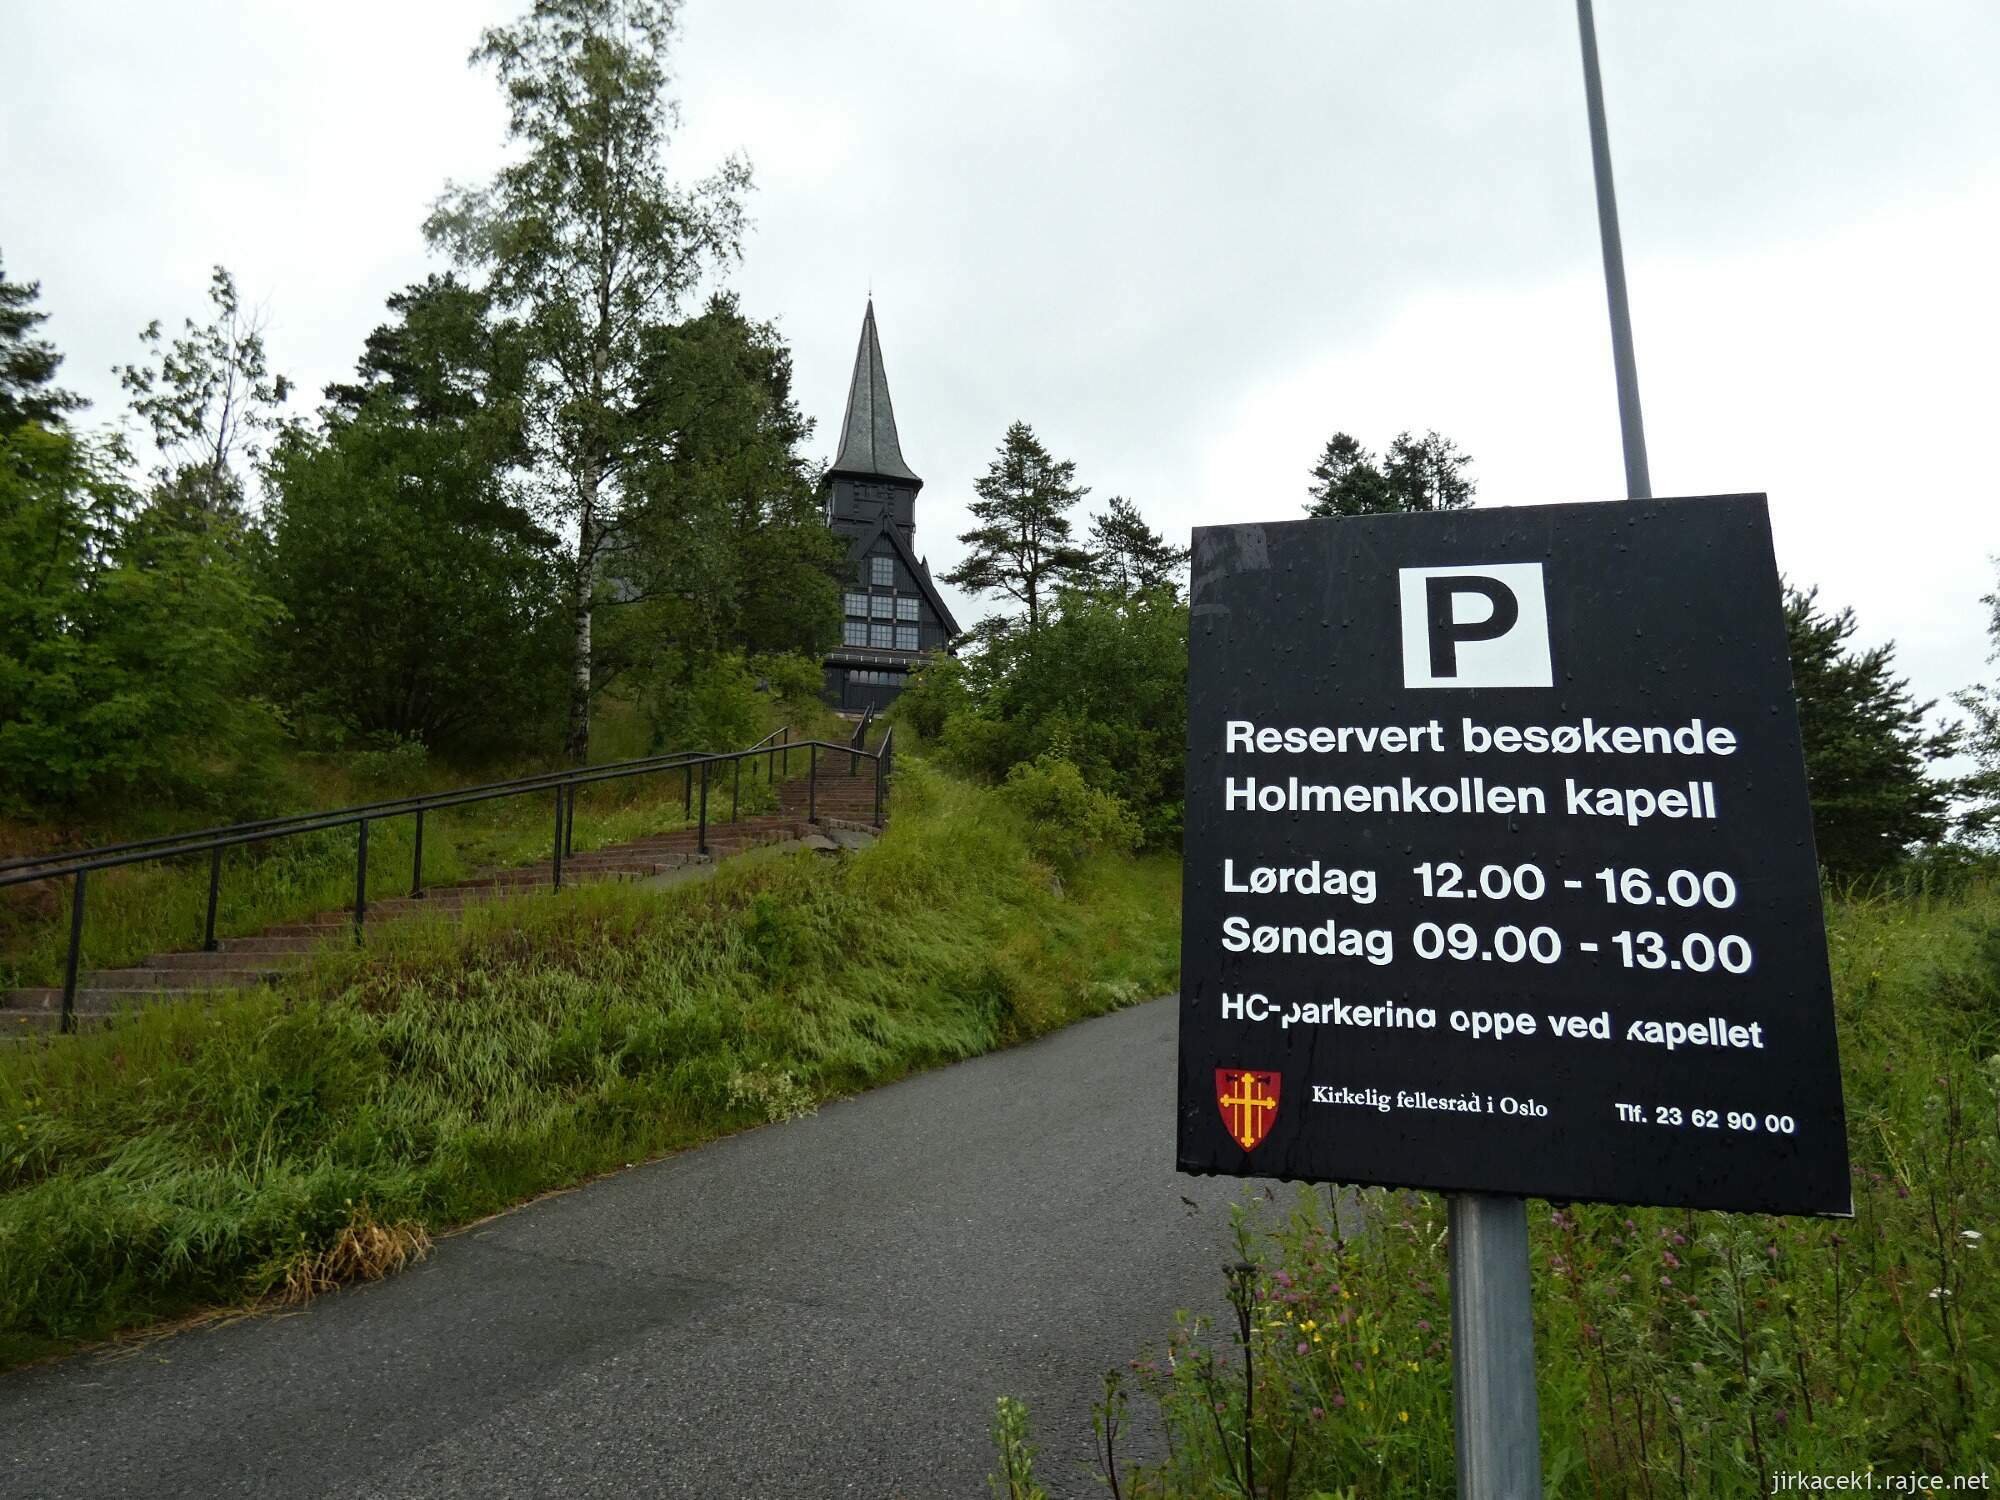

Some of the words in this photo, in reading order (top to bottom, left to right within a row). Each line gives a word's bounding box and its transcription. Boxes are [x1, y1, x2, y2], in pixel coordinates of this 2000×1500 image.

[1425, 575, 1518, 678] P
[1226, 719, 1445, 754] Reservert
[1462, 717, 1737, 755] besøkende
[1225, 776, 1546, 814] Holmenkollen
[1565, 778, 1717, 827] kapell
[1224, 858, 1377, 905] Lørdag
[1413, 862, 1546, 901] 12.00
[1595, 867, 1737, 909] 16.00
[1221, 916, 1394, 966] Søndag
[1412, 922, 1562, 964] 09.00
[1611, 930, 1752, 974] 13.00
[1449, 1010, 1537, 1041] oppe
[1547, 1011, 1611, 1040] ved
[1626, 1017, 1764, 1051] kapellet
[1312, 1085, 1392, 1113] Kirkelig
[1486, 1095, 1494, 1114] i
[1500, 1096, 1548, 1117] Oslo
[1615, 1102, 1648, 1123] Tlf.
[1655, 1106, 1683, 1126] 23
[1691, 1108, 1719, 1129] 62
[1726, 1111, 1757, 1131] 90
[1764, 1114, 1795, 1134] 00
